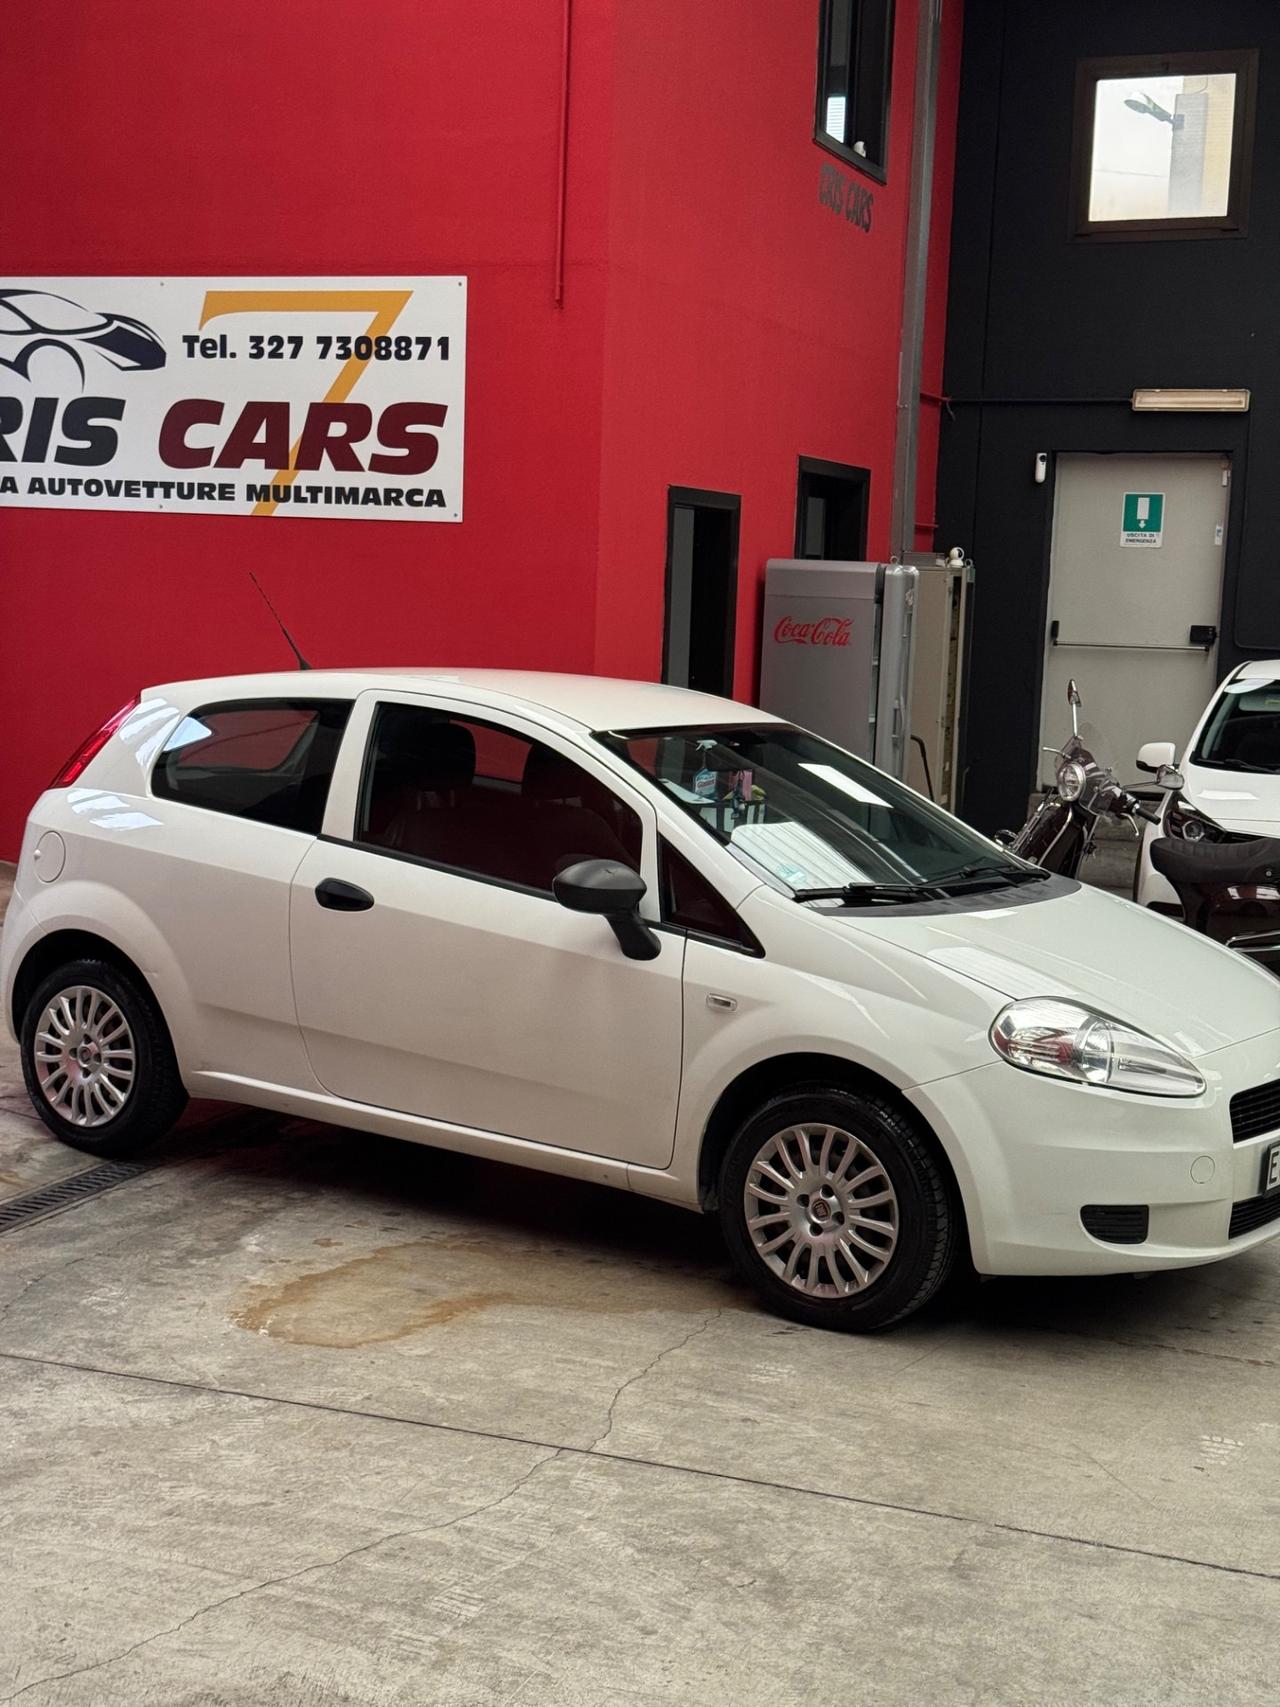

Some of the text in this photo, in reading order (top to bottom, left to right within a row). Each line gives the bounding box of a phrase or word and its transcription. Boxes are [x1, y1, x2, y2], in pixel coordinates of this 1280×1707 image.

[846, 183, 874, 232] CARS
[182, 335, 450, 361] Tel. 327 7308871
[158, 398, 449, 475] CARS
[28, 477, 236, 501] AUTOVETTURE
[246, 483, 447, 508] MULTIMARCA
